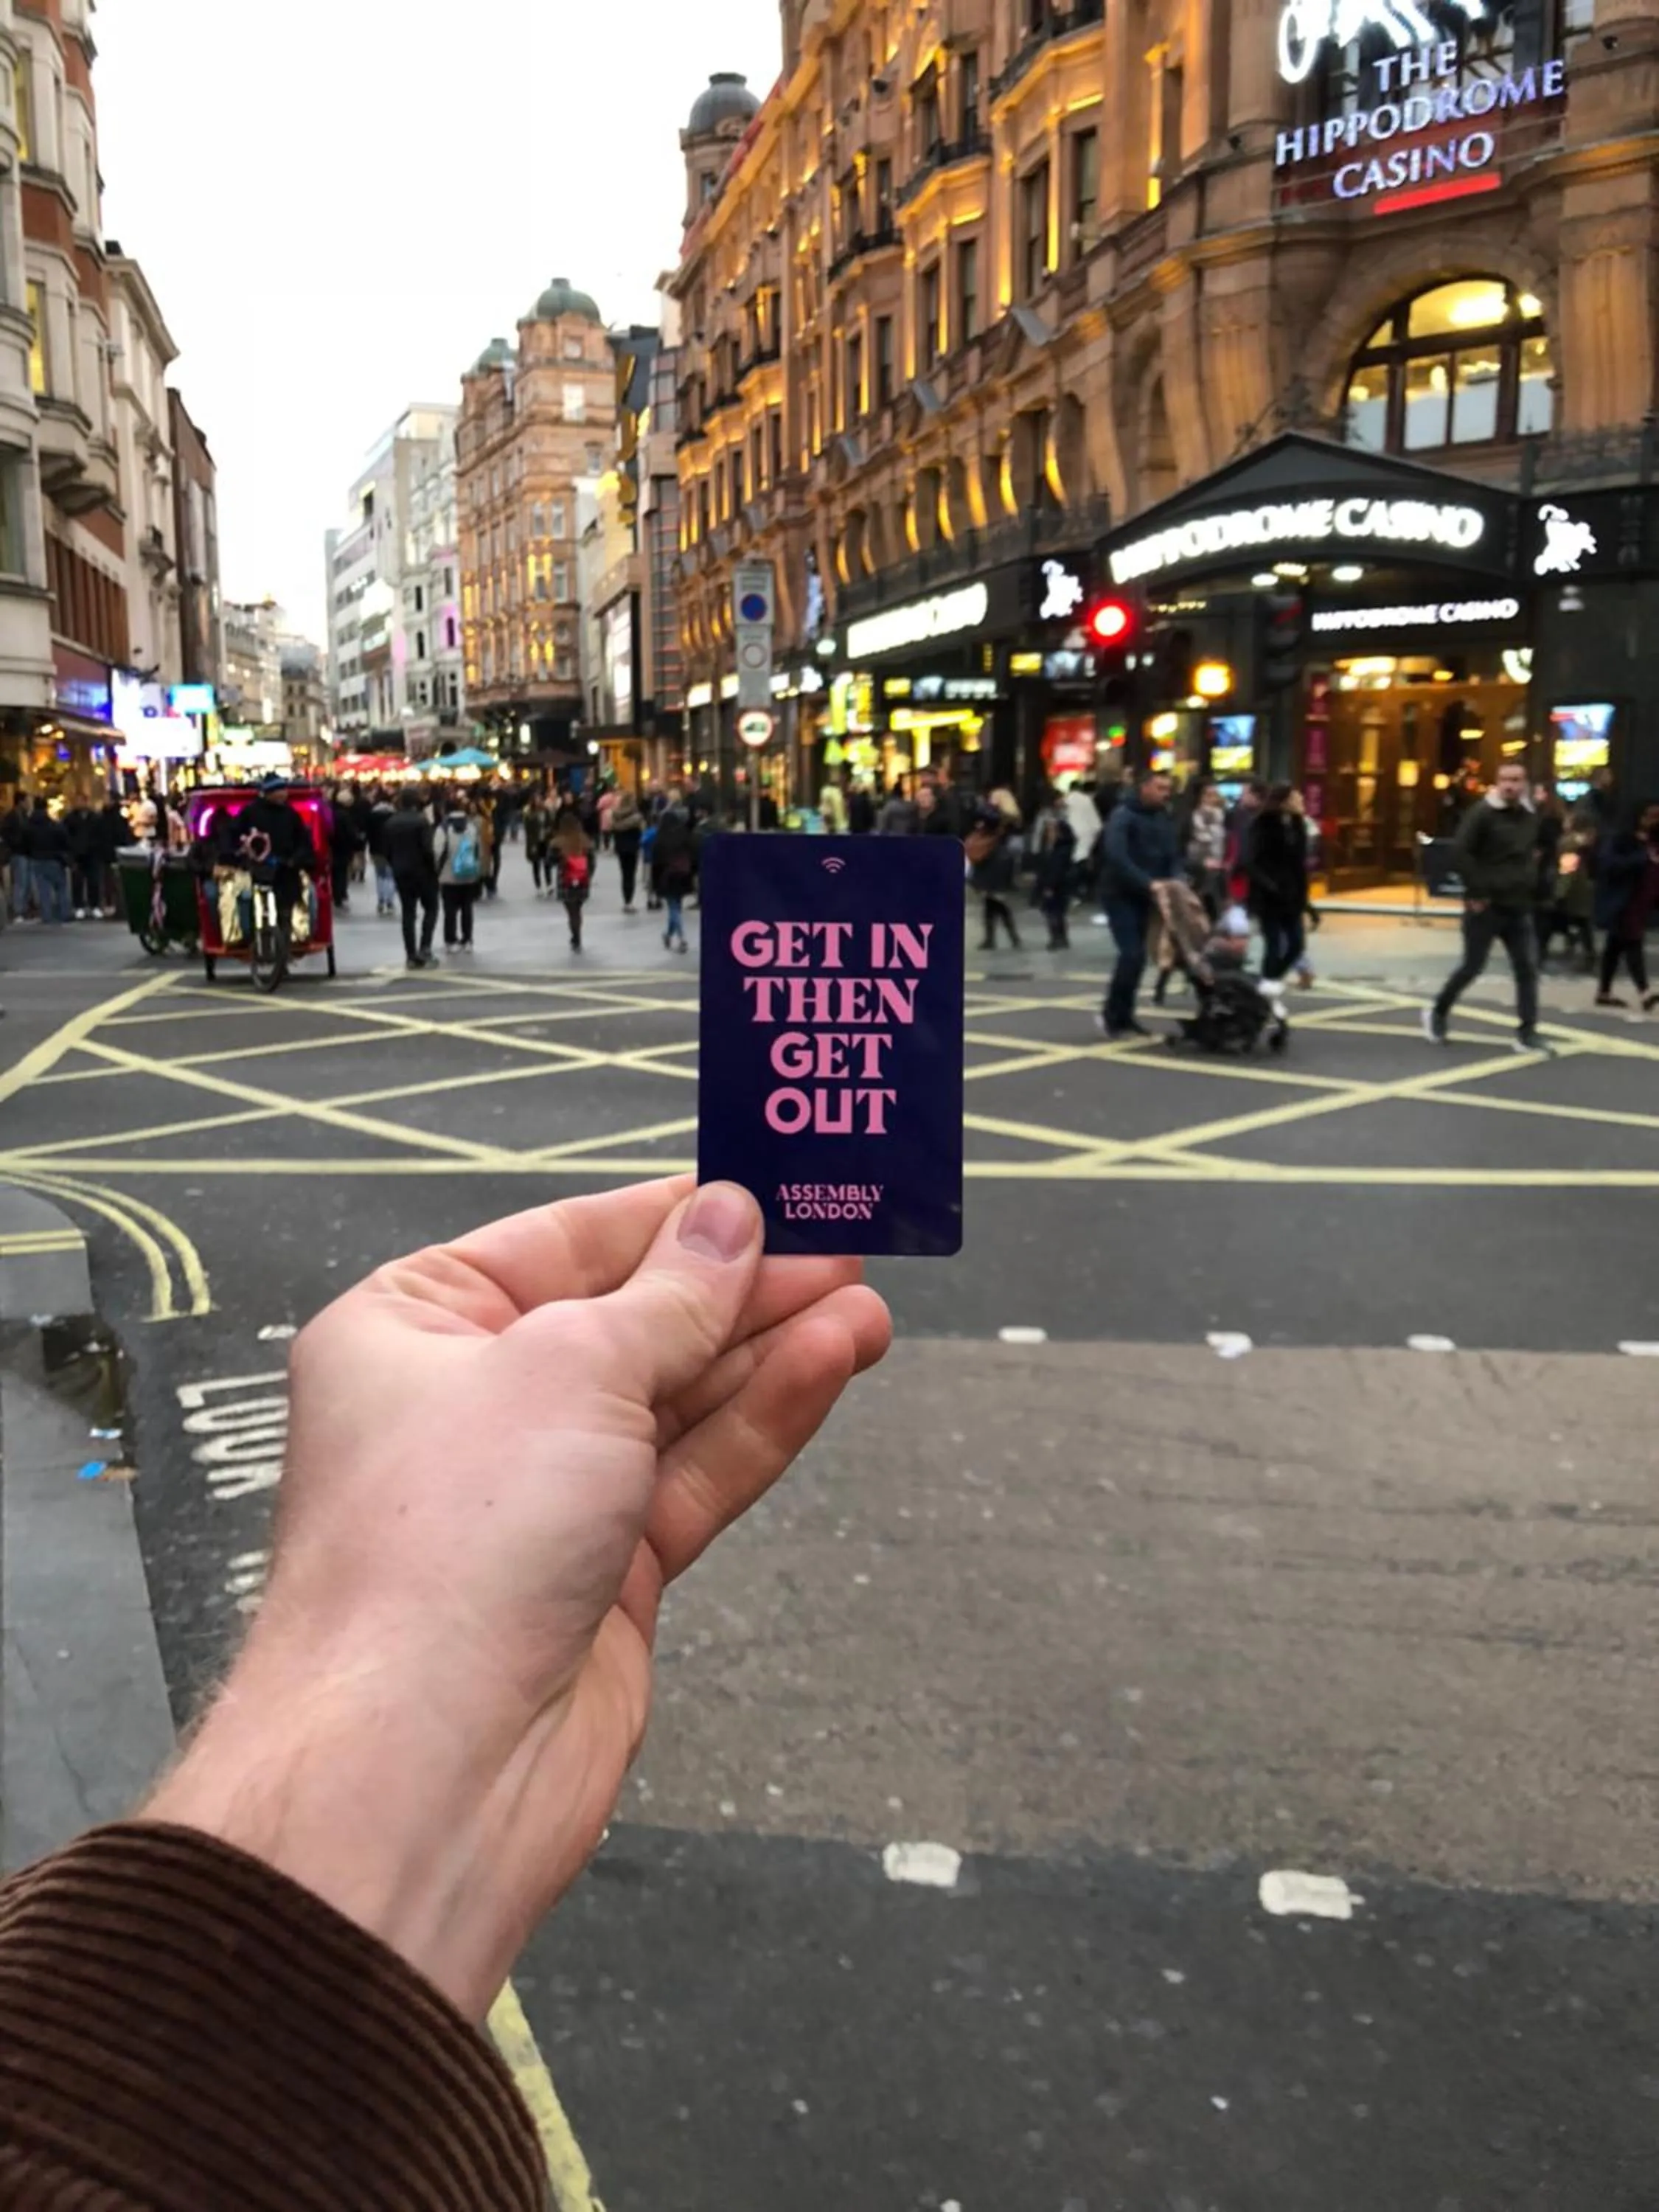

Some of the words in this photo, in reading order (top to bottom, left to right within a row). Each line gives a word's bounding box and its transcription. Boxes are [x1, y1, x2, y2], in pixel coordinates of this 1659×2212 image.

[1373, 39, 1457, 93] THE
[1275, 59, 1565, 167] HIPPODROME
[1332, 131, 1495, 200] CASINO
[730, 920, 852, 968] GET
[871, 922, 934, 969] IN
[743, 976, 919, 1023] THEN
[770, 1032, 892, 1079] GET
[765, 1087, 897, 1134] OUT
[776, 1183, 884, 1203] ASSEMBLY
[785, 1203, 872, 1220] LONDON
